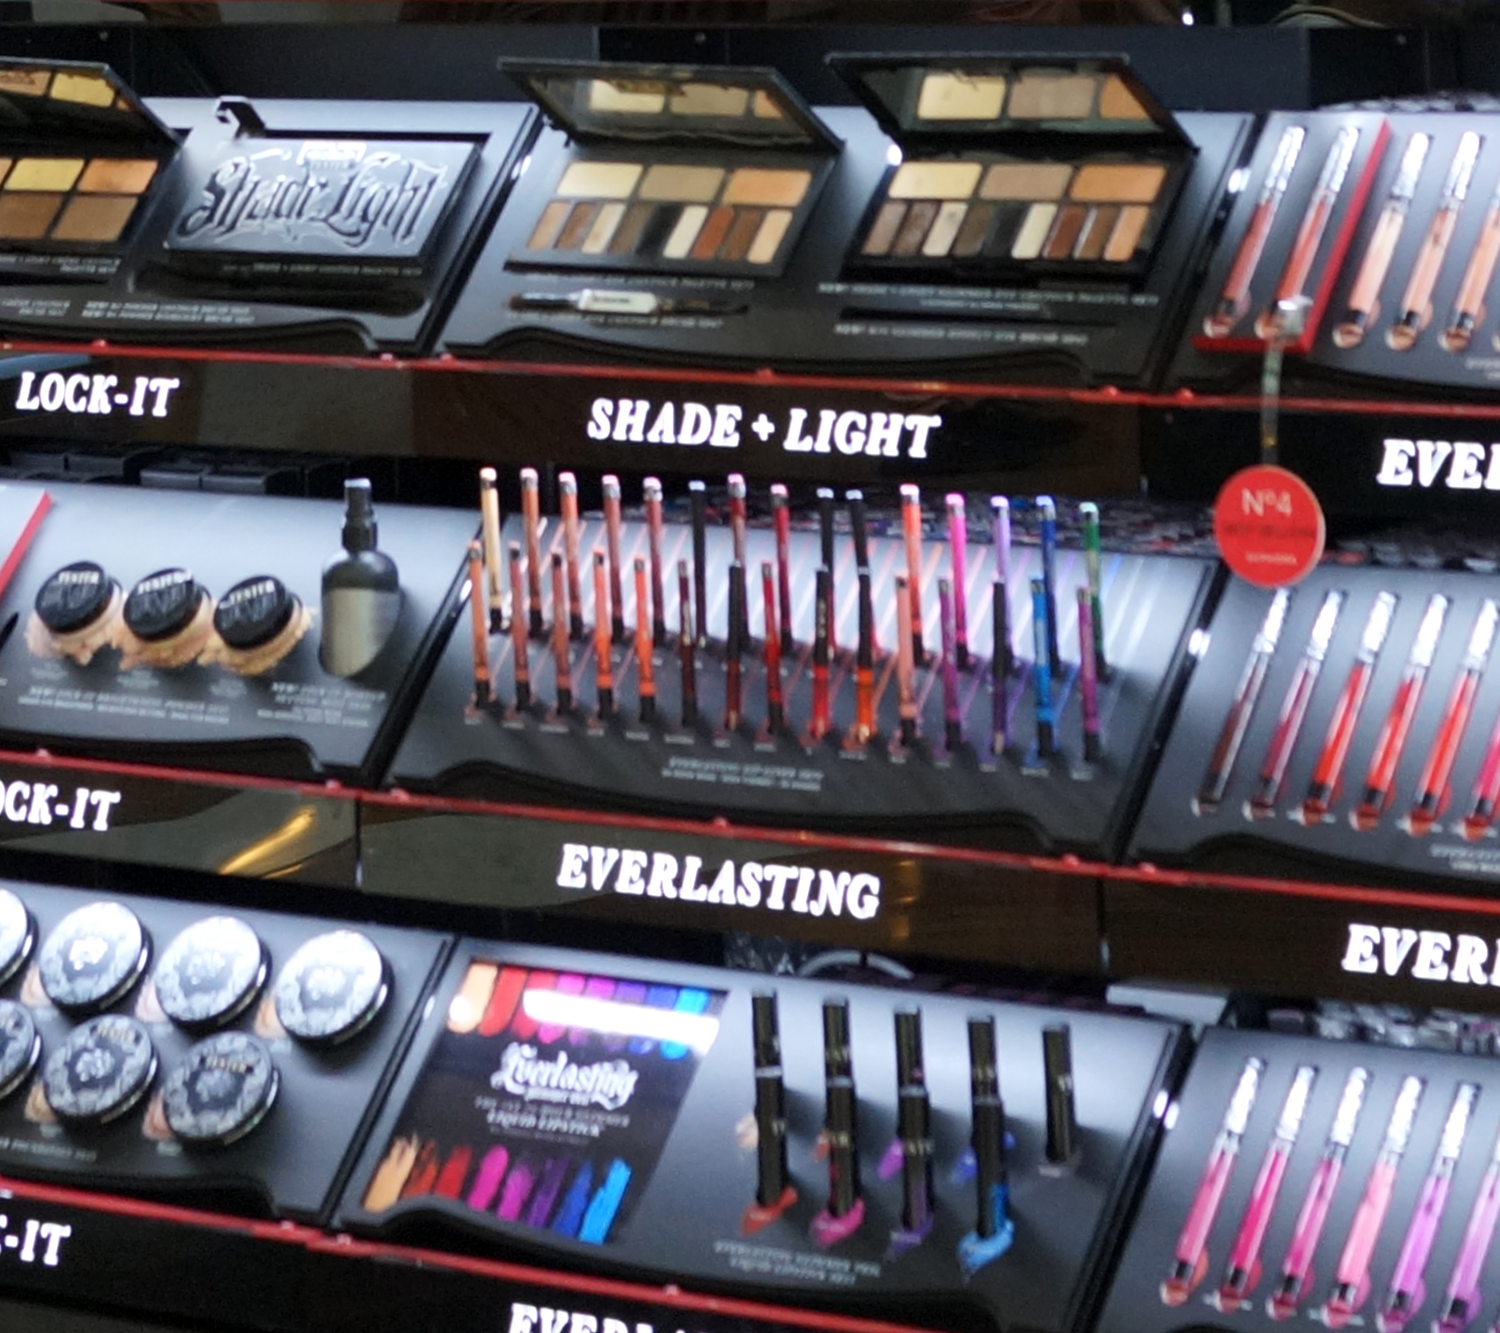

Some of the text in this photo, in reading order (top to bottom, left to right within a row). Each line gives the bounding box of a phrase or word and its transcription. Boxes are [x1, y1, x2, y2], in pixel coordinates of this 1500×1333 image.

[15, 370, 180, 418] LOCK-IT
[586, 397, 741, 449] SHADE
[784, 408, 942, 460] LIGHT
[556, 842, 881, 920] EVERLASTING
